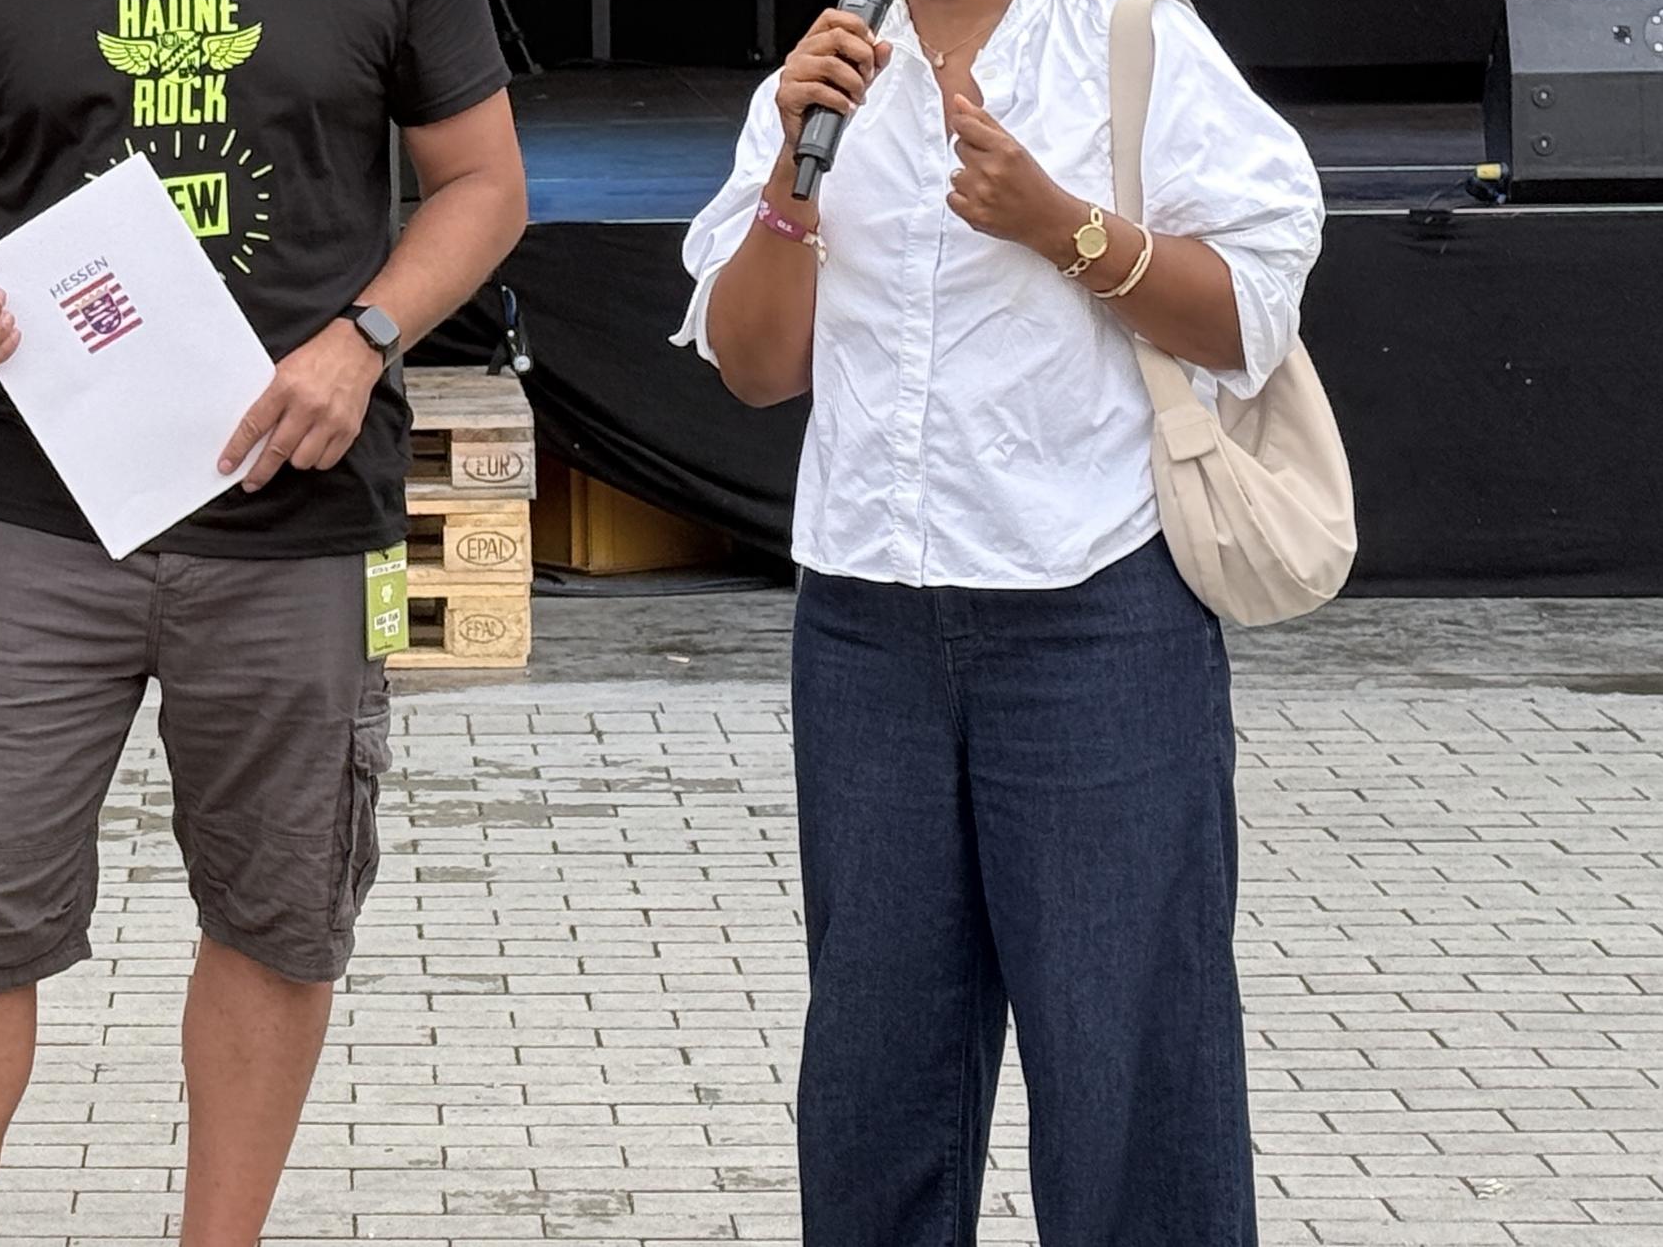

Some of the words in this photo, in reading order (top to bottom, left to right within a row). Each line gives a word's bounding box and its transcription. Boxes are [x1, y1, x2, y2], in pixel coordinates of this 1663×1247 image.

[133, 73, 227, 127] ROCK
[49, 256, 109, 300] HESSEN
[476, 455, 511, 477] EUR
[466, 537, 506, 560] EPAL
